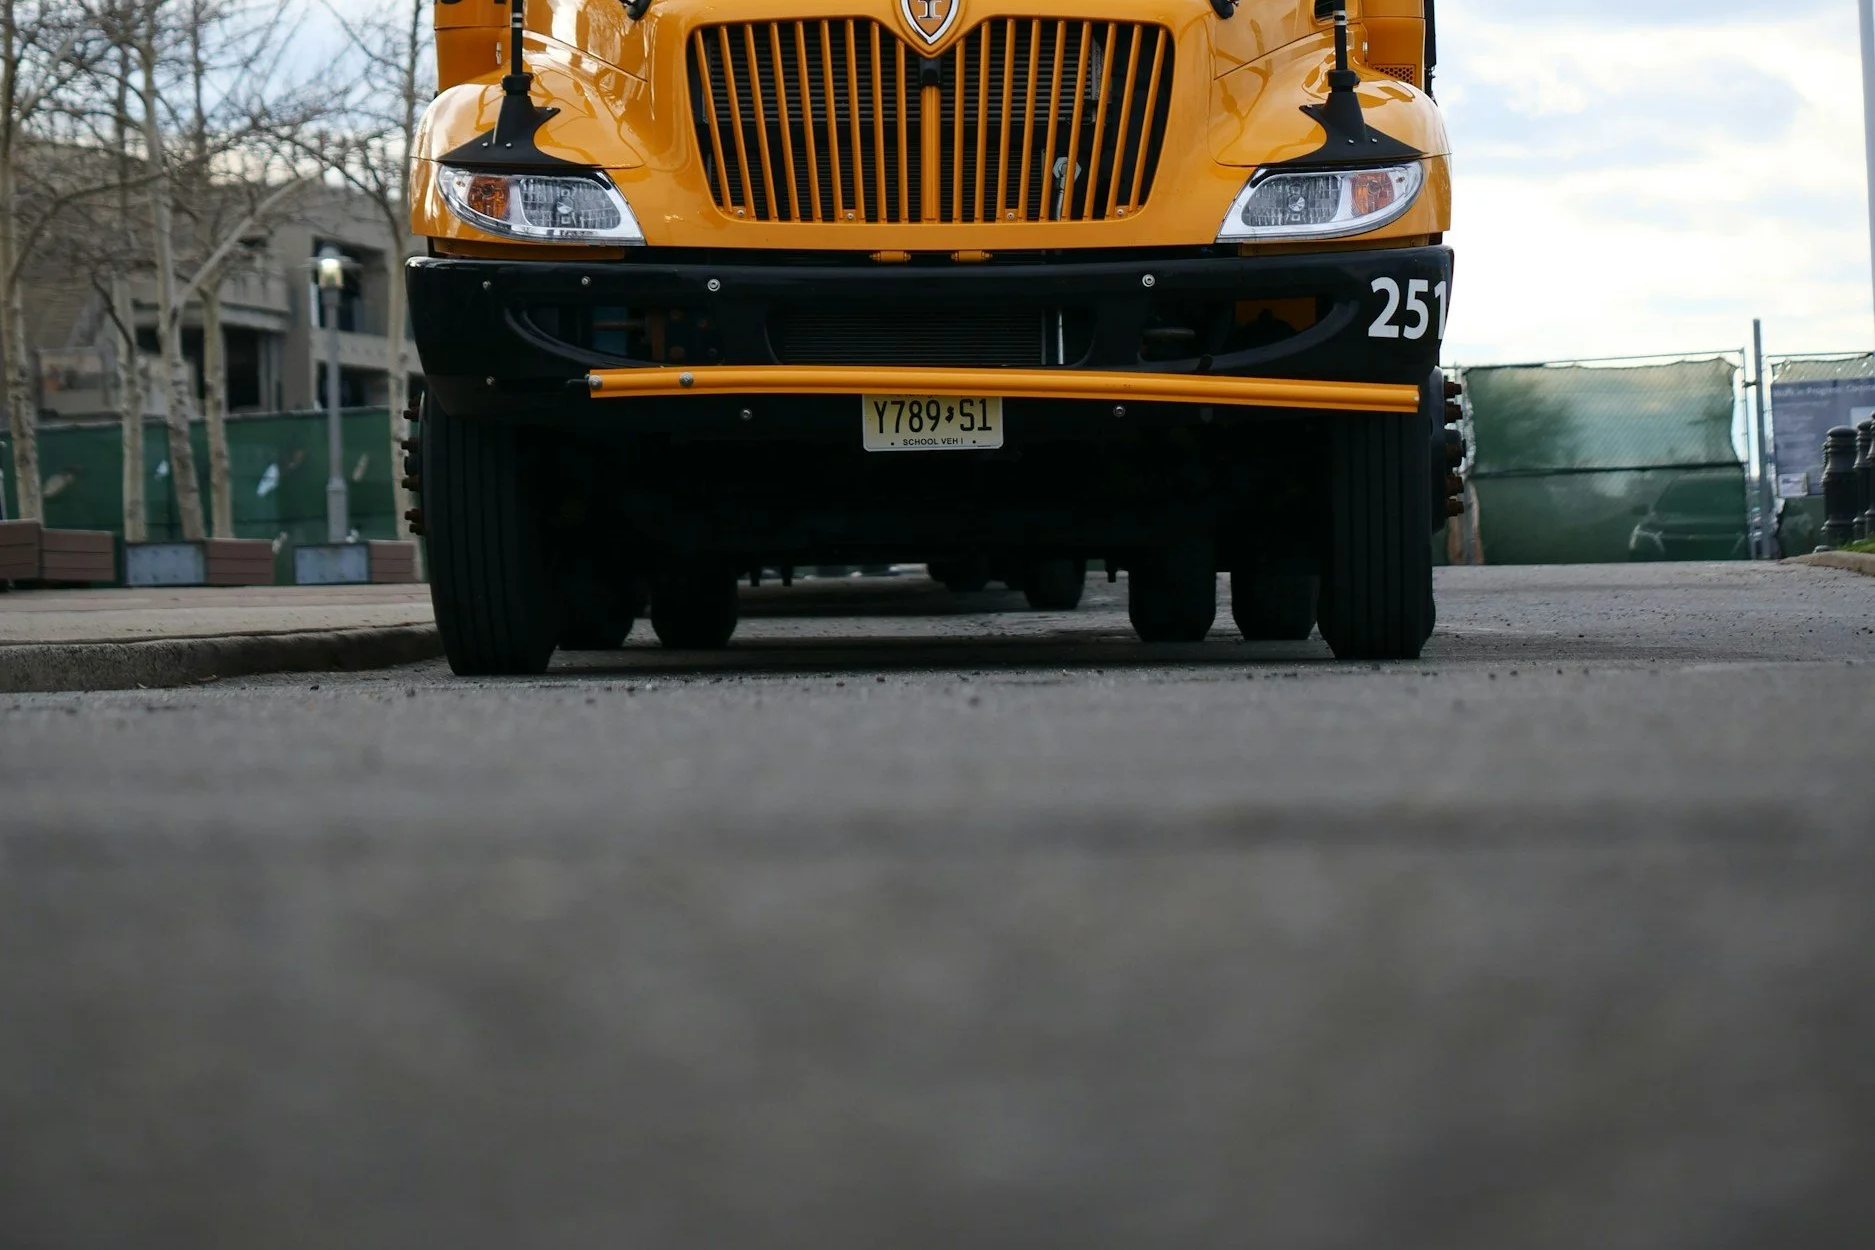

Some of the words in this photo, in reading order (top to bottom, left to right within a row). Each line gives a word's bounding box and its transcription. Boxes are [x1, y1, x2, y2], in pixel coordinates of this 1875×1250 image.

[1367, 276, 1447, 340] 251
[873, 399, 941, 434] Y789
[959, 397, 993, 432] S1
[902, 437, 938, 446] SCHOOL
[940, 437, 959, 445] VEH
